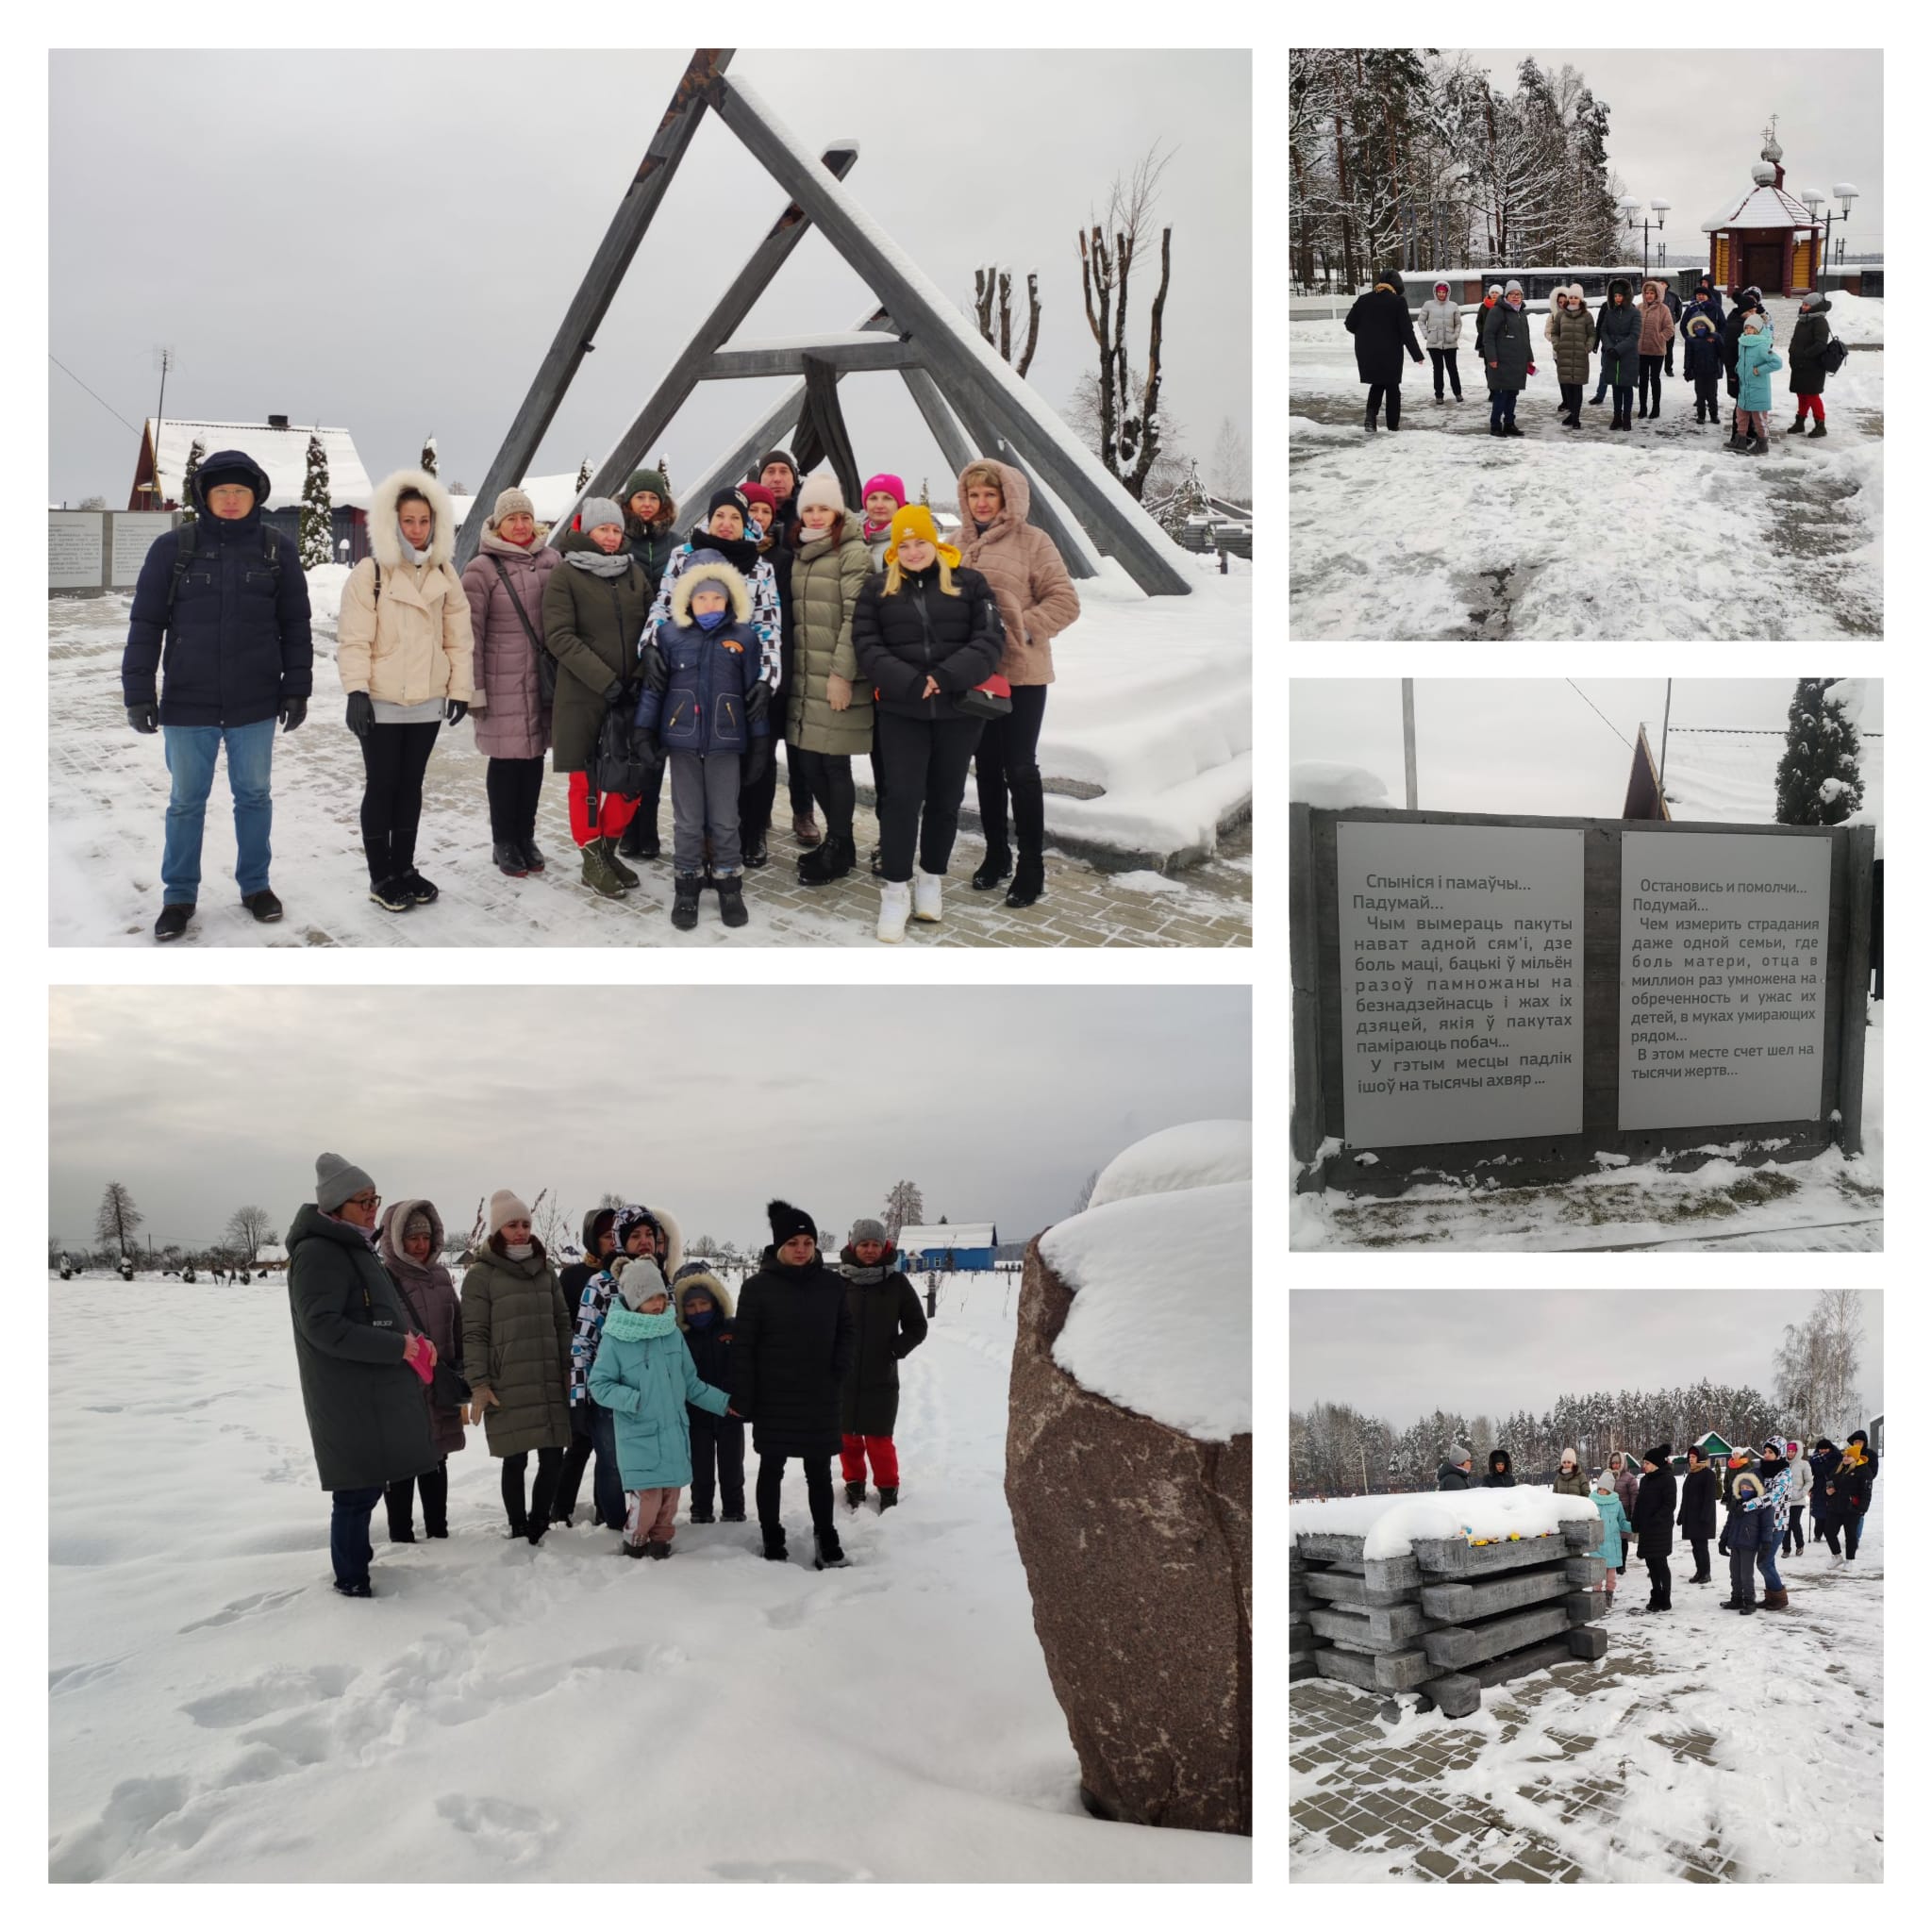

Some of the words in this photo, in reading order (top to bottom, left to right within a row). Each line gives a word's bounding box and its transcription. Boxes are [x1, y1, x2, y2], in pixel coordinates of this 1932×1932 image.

[1366, 874, 1435, 889] Спыніся
[1445, 875, 1531, 892] памаўчы...
[1640, 879, 1724, 892] Остановись
[1725, 883, 1735, 893] и
[1737, 883, 1807, 894] помолчи...
[1353, 895, 1444, 912] Падумай...
[1632, 898, 1708, 913] Подумай...
[1367, 916, 1406, 929] Чым
[1416, 920, 1504, 933] вымераць
[1513, 920, 1573, 933] пакуты
[1640, 917, 1669, 929] Чем
[1675, 920, 1742, 933] измерить
[1747, 921, 1820, 933] страдания
[1354, 940, 1409, 951] нават
[1420, 937, 1476, 953] адной
[1542, 939, 1573, 951] дзе
[1631, 939, 1674, 951] даже
[1683, 936, 1729, 951] одной
[1739, 938, 1786, 950] семьи,
[1795, 939, 1819, 950] где
[1355, 958, 1396, 971] боль
[1401, 957, 1443, 973] маці,
[1448, 957, 1501, 972] бацькі
[1506, 956, 1516, 973] ў
[1521, 956, 1573, 969] мільён
[1632, 955, 1674, 968] боль
[1684, 958, 1751, 970] матери,
[1761, 957, 1800, 968] отца
[1809, 957, 1818, 967] в
[1355, 977, 1414, 995] разоў
[1426, 978, 1540, 991] памножаны
[1551, 978, 1573, 989] на
[1631, 976, 1694, 987] миллион
[1698, 976, 1724, 988] раз
[1727, 974, 1797, 988] умножена
[1800, 974, 1817, 985] на
[1356, 997, 1493, 1013] безнадзейнасць
[1518, 997, 1550, 1008] жах
[1559, 994, 1573, 1007] іх
[1631, 992, 1731, 1008] обреченность
[1740, 993, 1749, 1004] и
[1757, 993, 1792, 1006] ужас
[1800, 992, 1817, 1002] их
[1356, 1017, 1427, 1035] дзяцей,
[1439, 1016, 1474, 1030] якія
[1486, 1015, 1495, 1031] ў
[1507, 1016, 1573, 1029] пакутах
[1630, 1010, 1677, 1025] детей,
[1680, 1013, 1689, 1024] в
[1691, 1011, 1734, 1024] муках
[1737, 1010, 1816, 1024] умирающих
[1357, 1039, 1447, 1055] паміраюць
[1450, 1035, 1509, 1049] побач...
[1630, 1031, 1688, 1045] рядом...
[1638, 1049, 1647, 1060] В
[1651, 1049, 1685, 1060] этом
[1689, 1049, 1729, 1059] месте
[1733, 1047, 1764, 1058] счет
[1767, 1045, 1794, 1057] шел
[1798, 1045, 1815, 1056] на
[1370, 1059, 1382, 1073] У
[1393, 1060, 1445, 1072] гэтым
[1456, 1057, 1508, 1069] месцы
[1519, 1051, 1573, 1067] падлік
[1630, 1067, 1682, 1079] тысячи
[1684, 1066, 1739, 1079] жертв...
[1357, 1078, 1396, 1094] ішоў
[1399, 1081, 1420, 1092] на
[1422, 1077, 1483, 1090] тысячы
[1486, 1074, 1532, 1088] ахвяр
